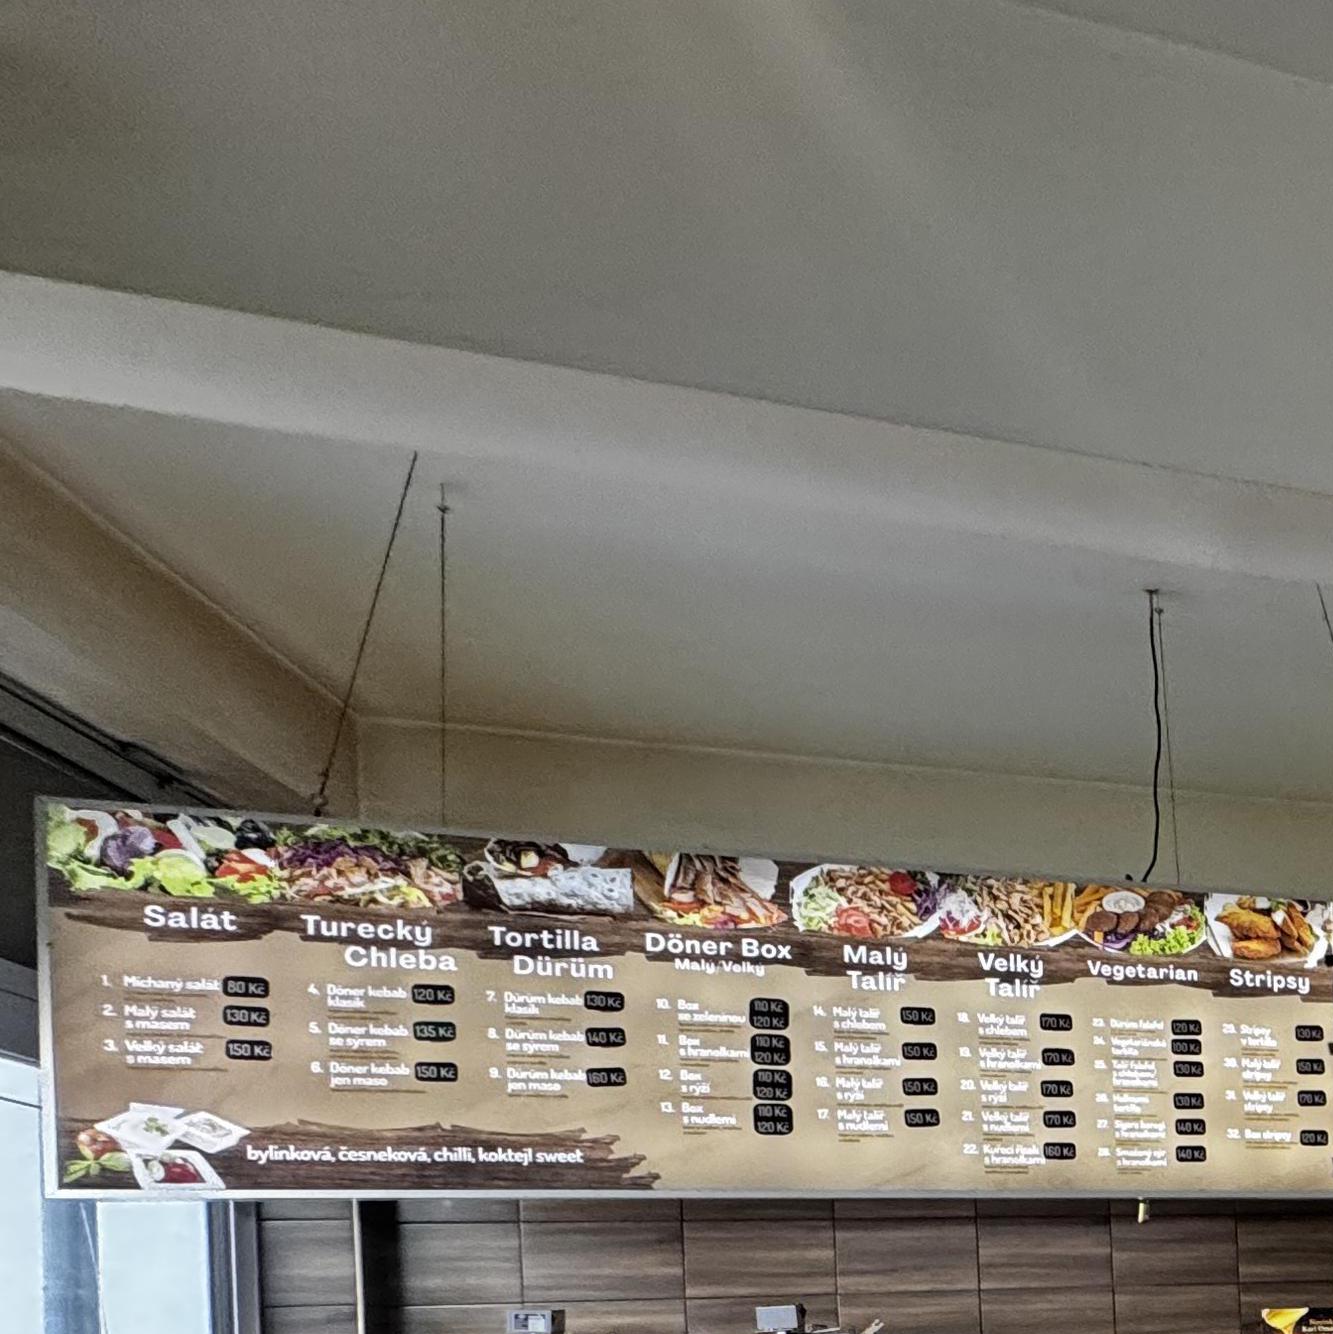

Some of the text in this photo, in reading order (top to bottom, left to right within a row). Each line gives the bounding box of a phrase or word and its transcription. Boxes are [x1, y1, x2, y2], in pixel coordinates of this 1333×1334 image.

[143, 904, 238, 931] Salát
[300, 914, 432, 947] Turecký
[487, 926, 600, 951] Tortilla
[644, 932, 793, 960] Döner Box
[344, 946, 458, 971] Chleba
[513, 955, 614, 979] Dürüm
[843, 944, 907, 971] Malý
[977, 952, 1044, 979] Velký
[846, 970, 906, 992] Talíř
[1087, 960, 1198, 982] Vegetarian
[1229, 969, 1310, 995] Stripsy
[227, 981, 245, 993] 80
[248, 982, 265, 994] Kč
[368, 985, 407, 999] kebab
[413, 989, 434, 1001] 120
[437, 989, 452, 1001] Kč
[985, 978, 1041, 999] Talíř
[225, 1009, 249, 1022] 130
[251, 1010, 267, 1024] Kč
[368, 1024, 409, 1037] kebab
[415, 1026, 436, 1038] 135
[438, 1026, 454, 1038] Kč
[228, 1044, 251, 1056] 150
[254, 1045, 270, 1057] Kč
[370, 1064, 410, 1076] kebab
[416, 1066, 438, 1078] 150
[440, 1067, 456, 1079] Kč
[246, 1145, 584, 1166] bylinková, česneková, chilli, koktejl sweet
